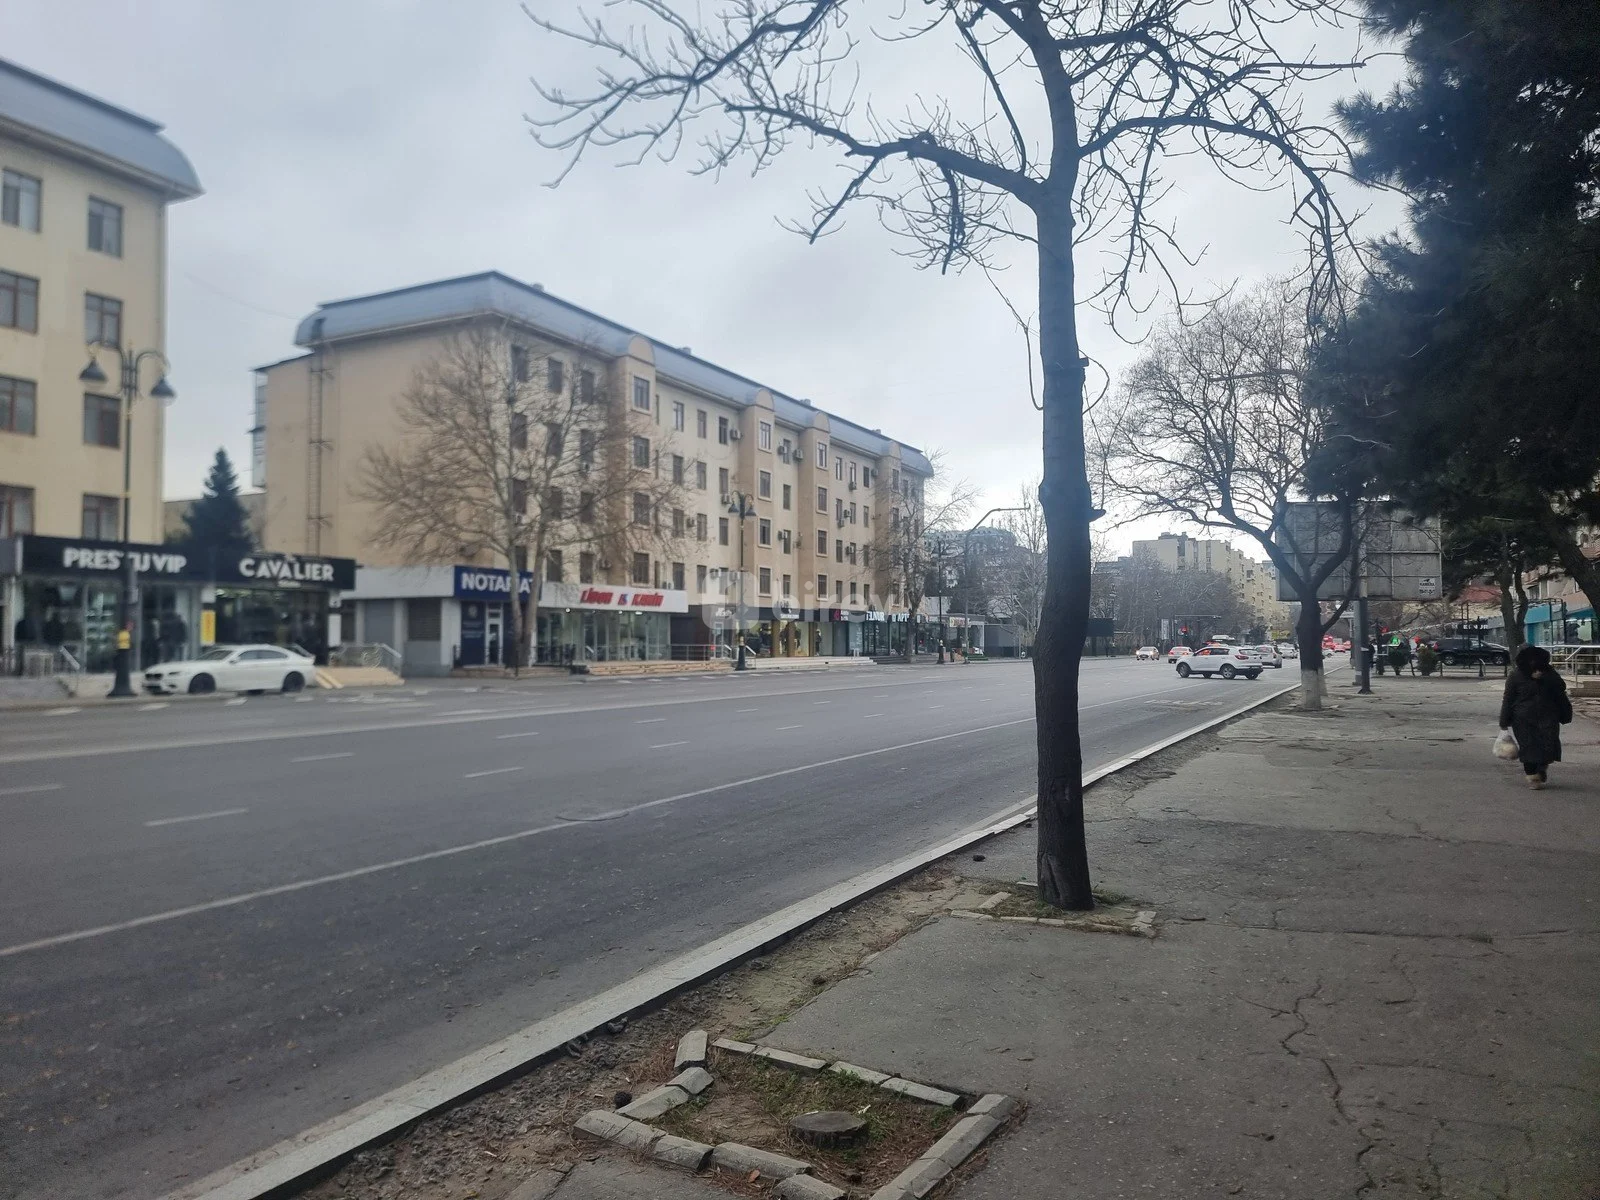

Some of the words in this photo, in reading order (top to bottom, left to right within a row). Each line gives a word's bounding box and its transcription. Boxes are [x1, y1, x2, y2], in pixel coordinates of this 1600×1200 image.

[152, 552, 187, 573] VIP
[239, 557, 335, 582] CAVALIER
[461, 573, 534, 594] NOTARA
